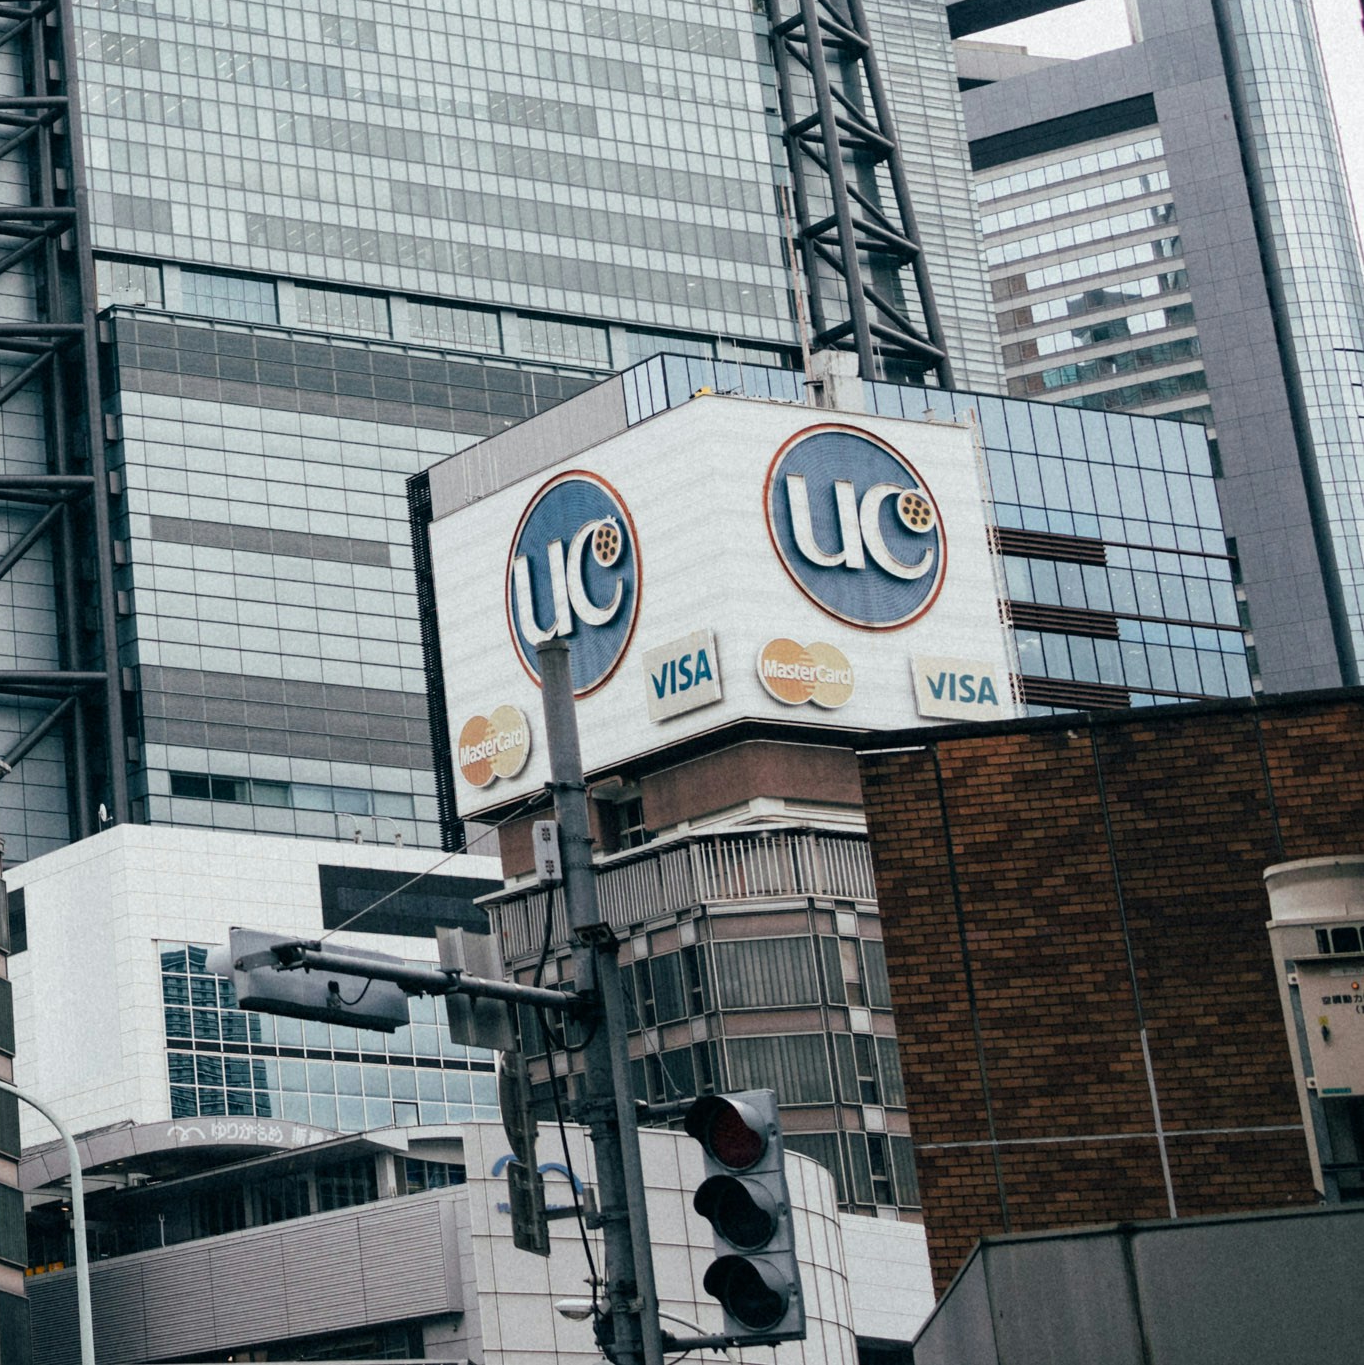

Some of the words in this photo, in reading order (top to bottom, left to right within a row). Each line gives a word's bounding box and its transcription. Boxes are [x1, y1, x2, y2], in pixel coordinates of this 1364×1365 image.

[650, 648, 713, 700] VISA
[763, 659, 852, 686] MasterCard
[926, 672, 999, 706] VISA
[459, 724, 524, 768] MasterCard
[210, 1121, 284, 1144] ゆりかもめ
